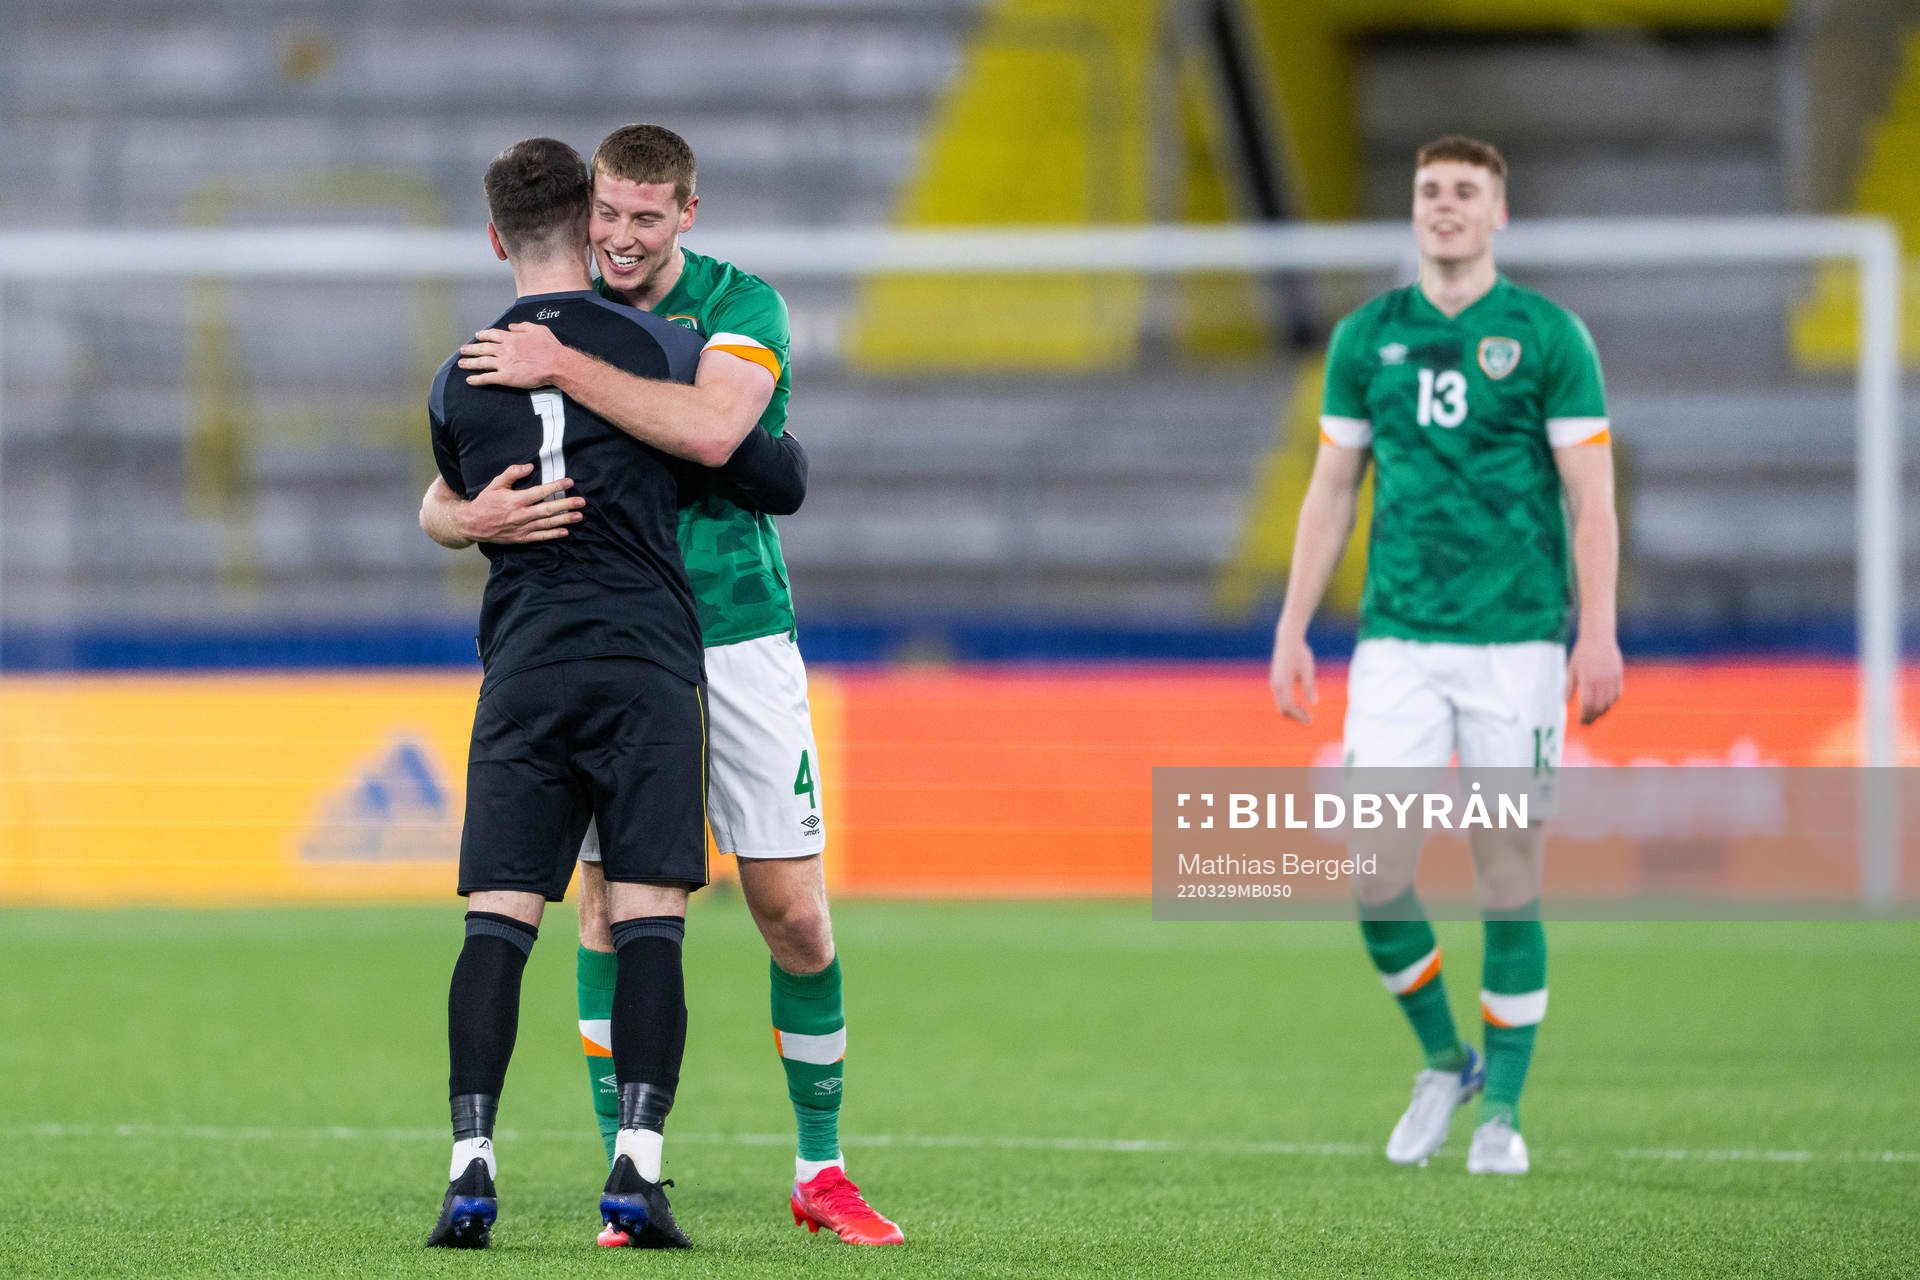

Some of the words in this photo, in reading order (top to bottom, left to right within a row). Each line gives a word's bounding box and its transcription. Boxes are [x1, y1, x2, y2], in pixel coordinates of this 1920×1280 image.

[536, 307, 560, 320] Éire
[1417, 368, 1468, 428] 13
[530, 391, 566, 502] 1
[793, 749, 816, 809] 4
